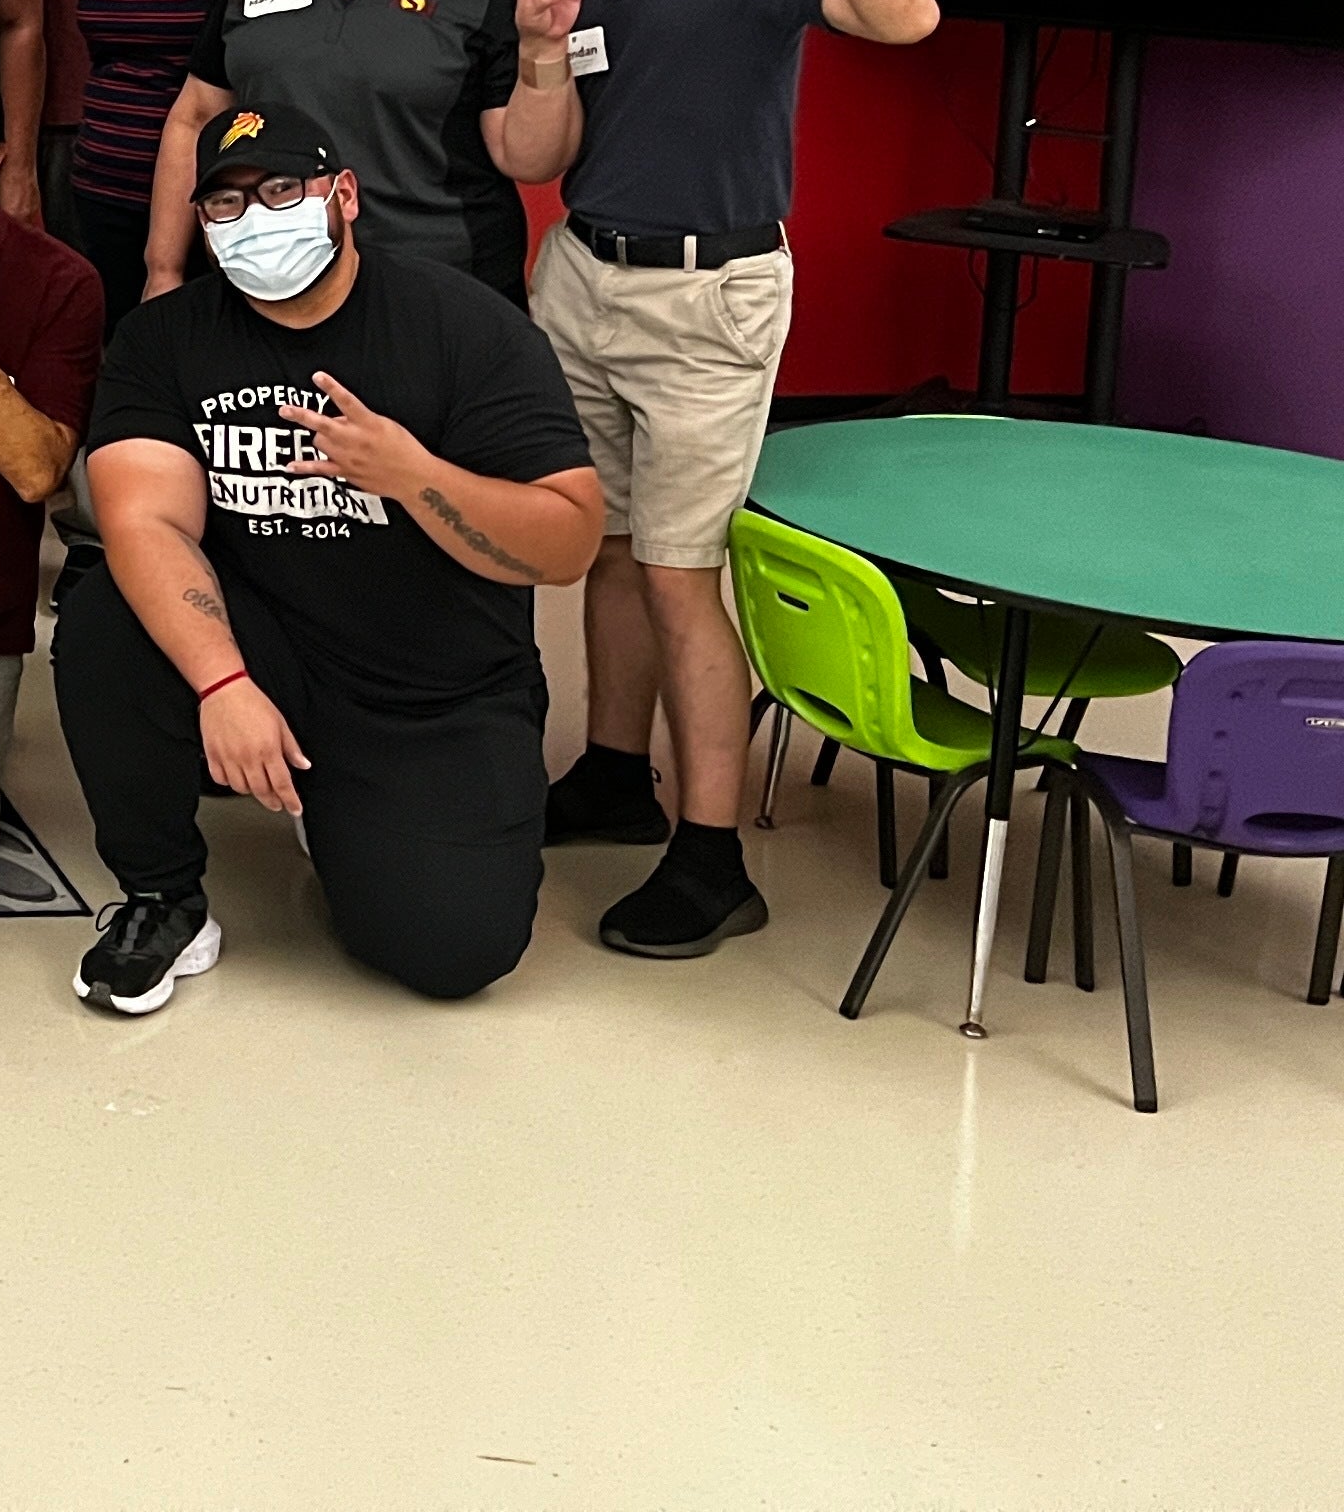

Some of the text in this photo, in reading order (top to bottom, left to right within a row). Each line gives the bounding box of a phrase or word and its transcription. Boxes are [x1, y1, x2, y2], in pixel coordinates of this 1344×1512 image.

[200, 385, 330, 419] PROPERTY
[214, 475, 370, 517] NUTRITION
[248, 518, 351, 539] EST. 2014
